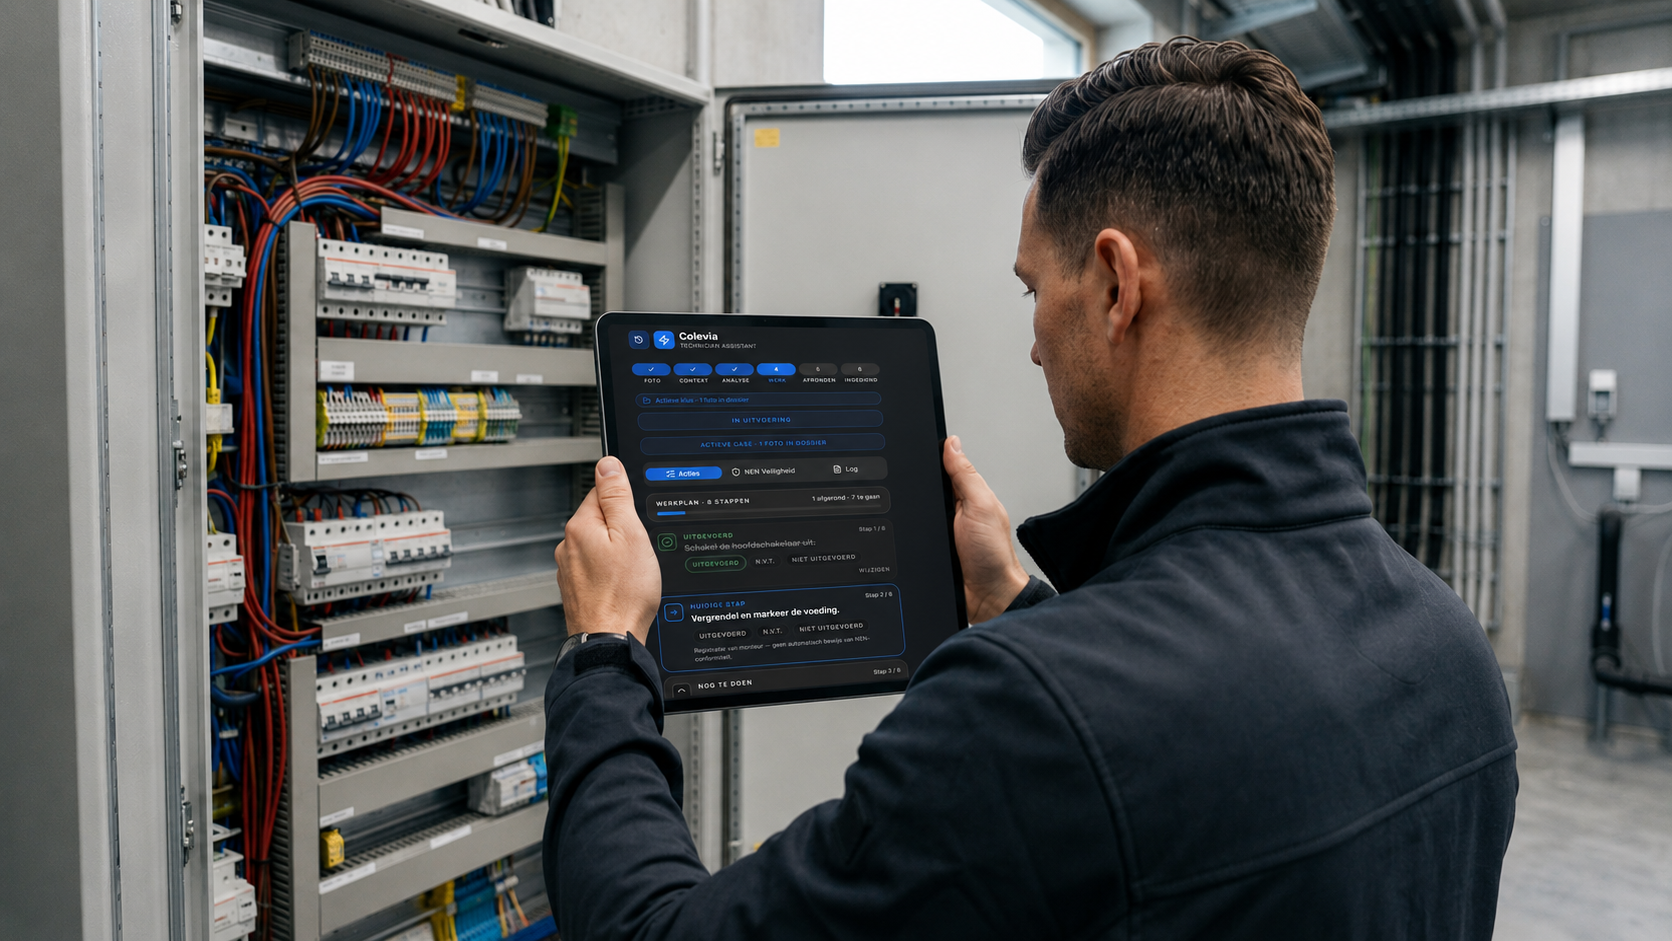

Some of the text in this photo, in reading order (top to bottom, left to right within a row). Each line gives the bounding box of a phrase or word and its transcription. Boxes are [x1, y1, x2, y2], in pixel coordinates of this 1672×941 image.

[679, 332, 718, 341] Colevia
[742, 416, 791, 424] UITVOERING
[678, 470, 701, 478] Acties
[683, 532, 734, 540] UITGEVOERD
[810, 554, 856, 562] UITGEVOERD
[692, 560, 740, 568] UITGEVOERD
[690, 600, 746, 610] HUIDIGE STAP
[690, 612, 740, 624] Vergrendel
[753, 610, 789, 619] markeer
[790, 608, 802, 616] de
[803, 606, 840, 616] voeding.
[818, 622, 864, 632] UITGEVOERD
[699, 630, 747, 640] UITGEVOERD
[698, 682, 716, 690] NOG
[730, 679, 753, 687] DOEN
